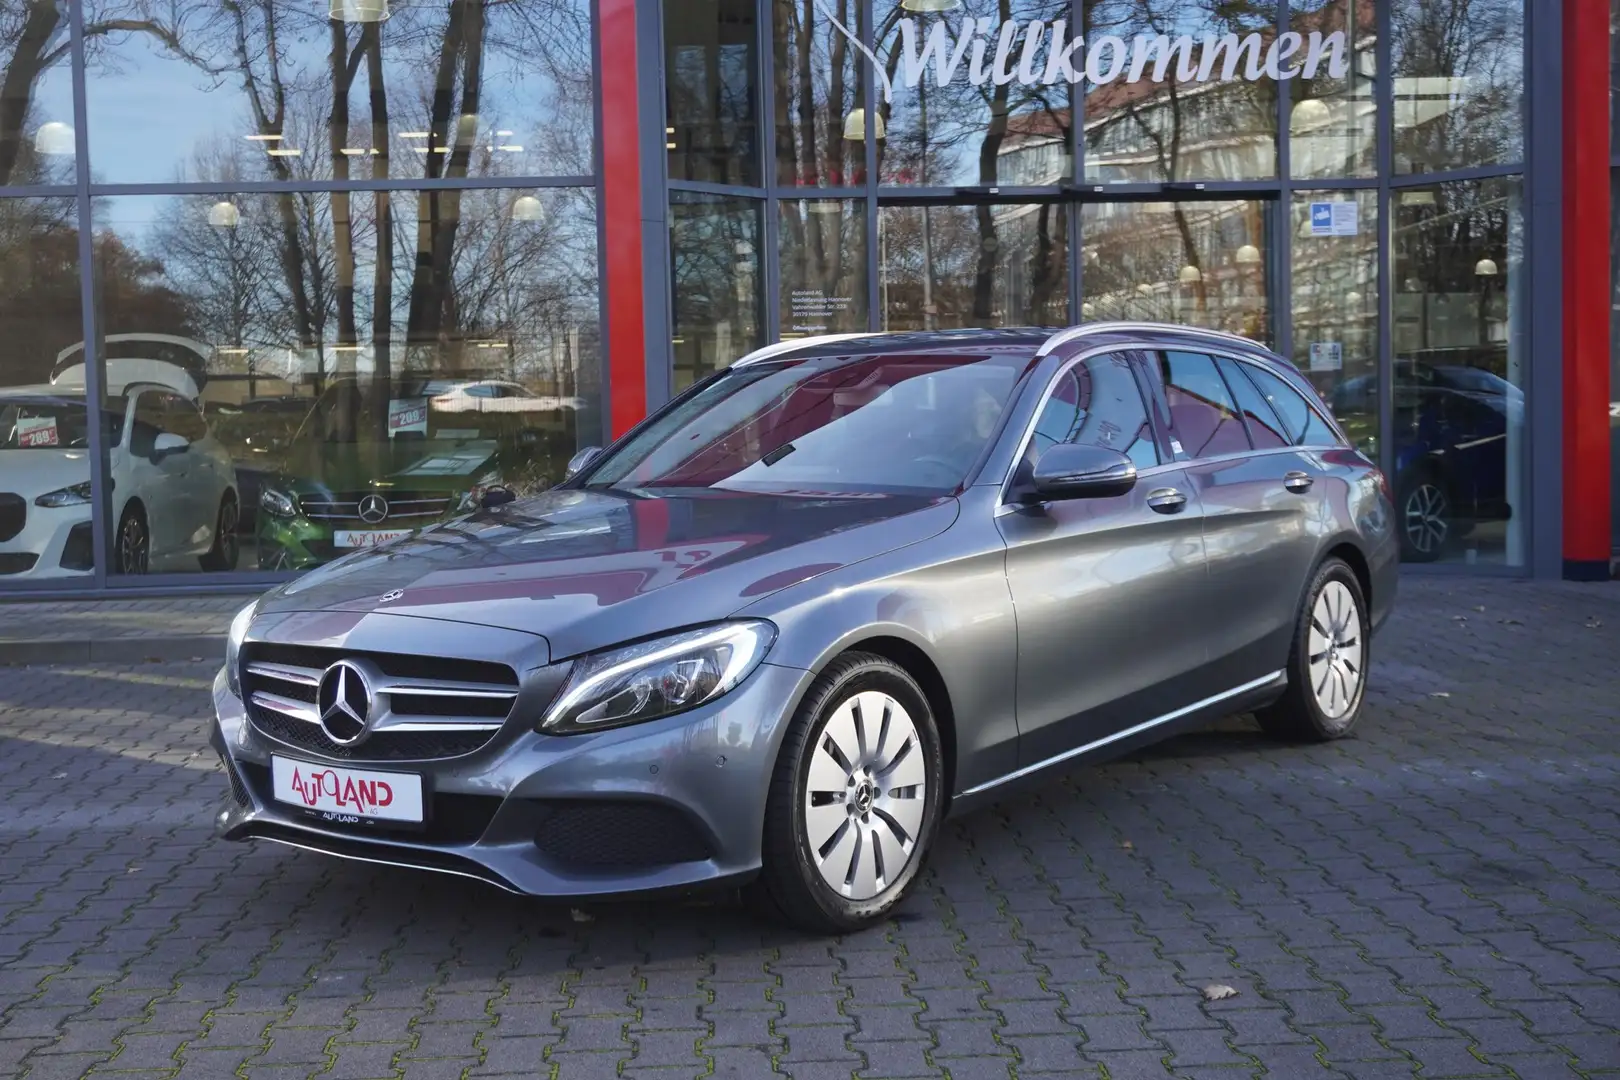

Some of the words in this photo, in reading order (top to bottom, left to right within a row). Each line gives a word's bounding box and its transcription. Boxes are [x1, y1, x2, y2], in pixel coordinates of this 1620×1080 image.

[899, 17, 1349, 87] Willkommen
[291, 765, 394, 814] AUTOLAND
[322, 812, 359, 823] AUTOLAND
